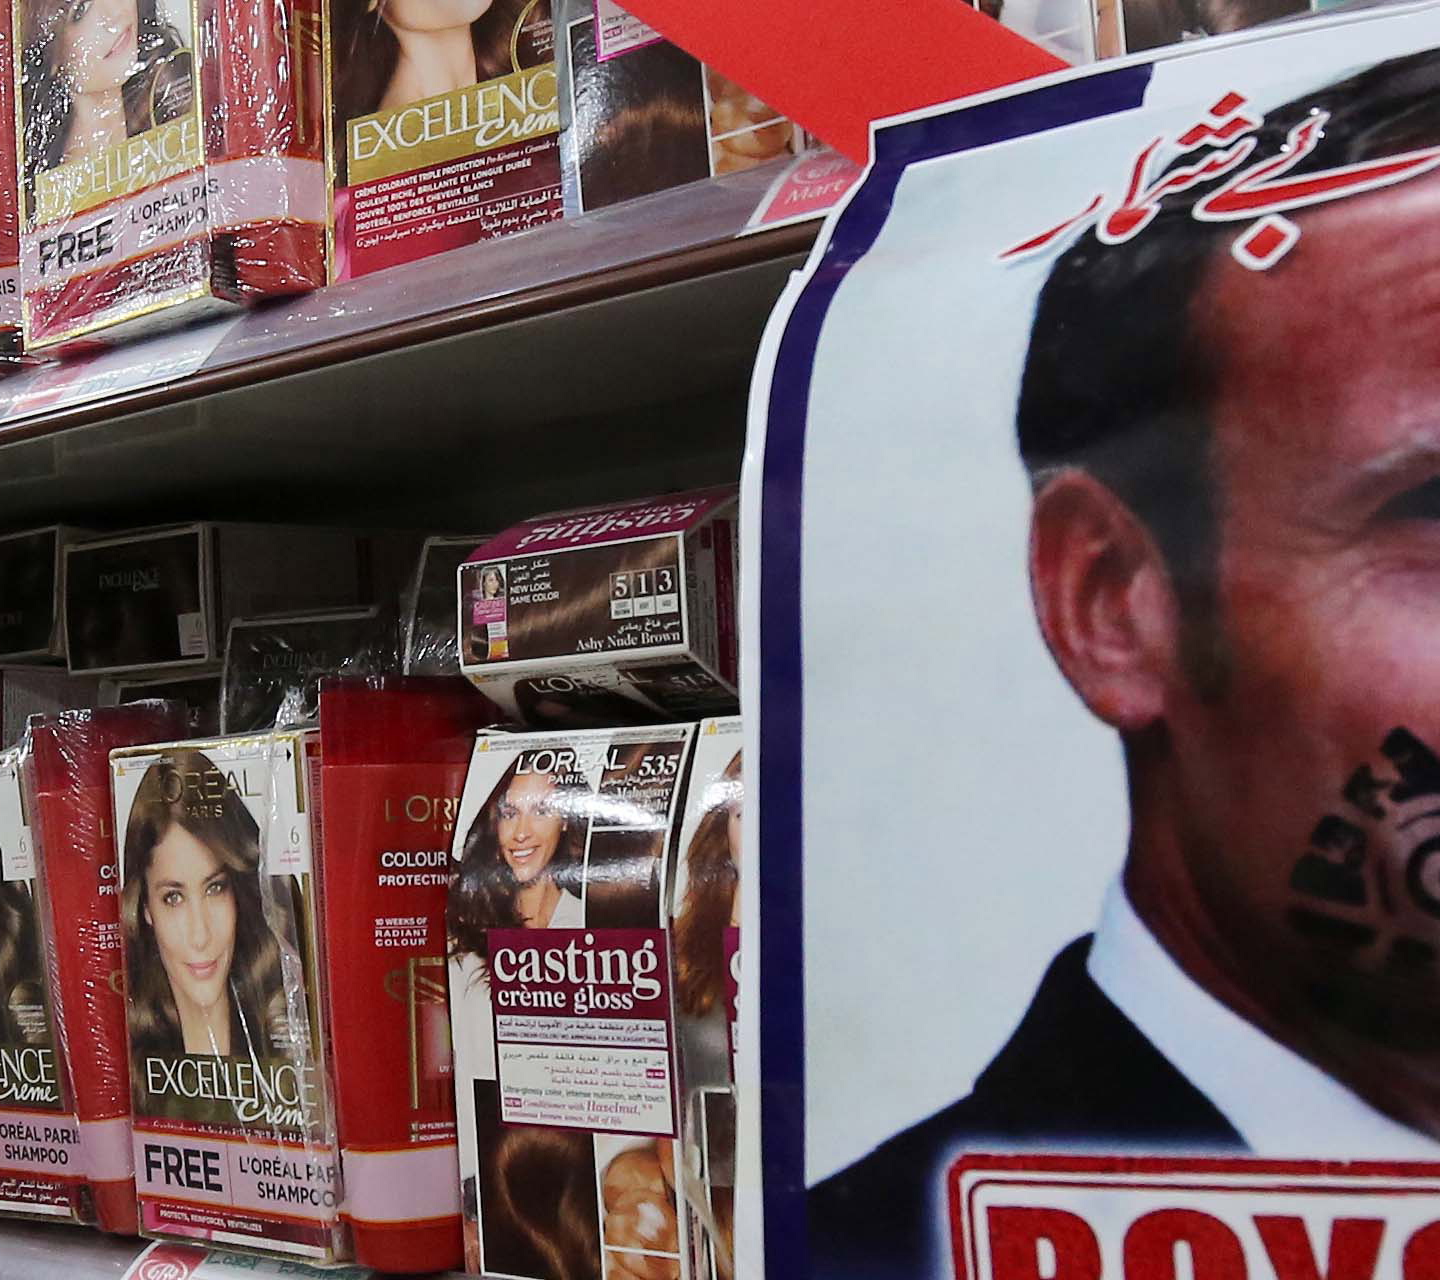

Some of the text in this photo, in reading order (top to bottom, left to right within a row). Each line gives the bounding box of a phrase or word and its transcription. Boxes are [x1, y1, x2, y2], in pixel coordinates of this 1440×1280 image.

[355, 166, 504, 210] COULEUR RICHE, BRILLANTE LONGUE
[377, 158, 486, 193] COLORANTE PROTECTION
[355, 180, 494, 220] COUVRE 100% DES CHEVEUX BLANCS
[785, 177, 846, 204] Mart
[131, 194, 189, 225] L'ORÉAL
[393, 194, 480, 223] RENFORCE, REVITALISE
[38, 219, 115, 277] FREE
[509, 581, 552, 595] NEW LOOK
[509, 591, 560, 606] SAME COLOR
[575, 631, 681, 652] Ashy Nude Brown
[516, 748, 626, 776] L'ORÉAL
[638, 755, 680, 775] 535
[546, 773, 588, 785] PARIS
[289, 825, 301, 844] 6
[381, 851, 448, 868] COLOUR
[374, 929, 428, 938] RADIANT
[385, 917, 428, 926] WEEKS OF
[374, 938, 427, 947] COLOUR
[494, 933, 662, 1000] casting
[497, 984, 634, 1015] crème gloss
[146, 1058, 317, 1107] EXCELLENCE
[523, 1100, 567, 1110] Conditioner
[3, 1143, 69, 1166] SHAMPOO
[144, 1143, 224, 1193] FREE
[239, 1155, 302, 1181] L'ORÉAL
